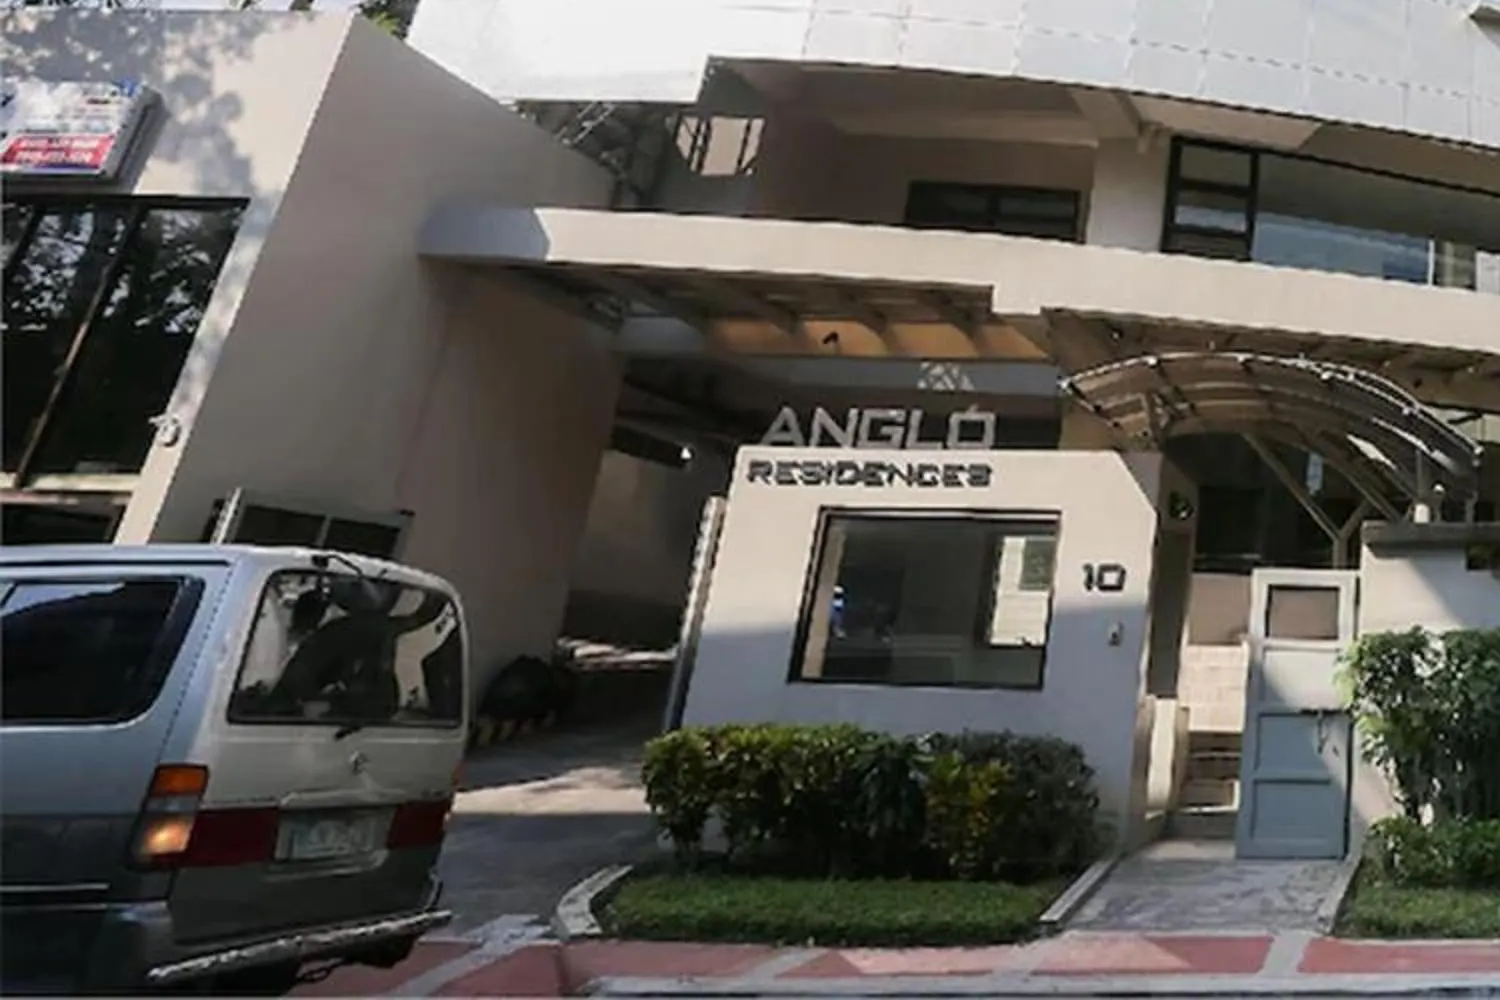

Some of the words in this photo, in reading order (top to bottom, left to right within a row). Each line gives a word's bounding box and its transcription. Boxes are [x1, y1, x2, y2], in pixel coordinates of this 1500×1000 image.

[760, 406, 996, 449] ANGLO
[747, 460, 993, 487] RESIDENCES
[1082, 563, 1126, 592] 10
